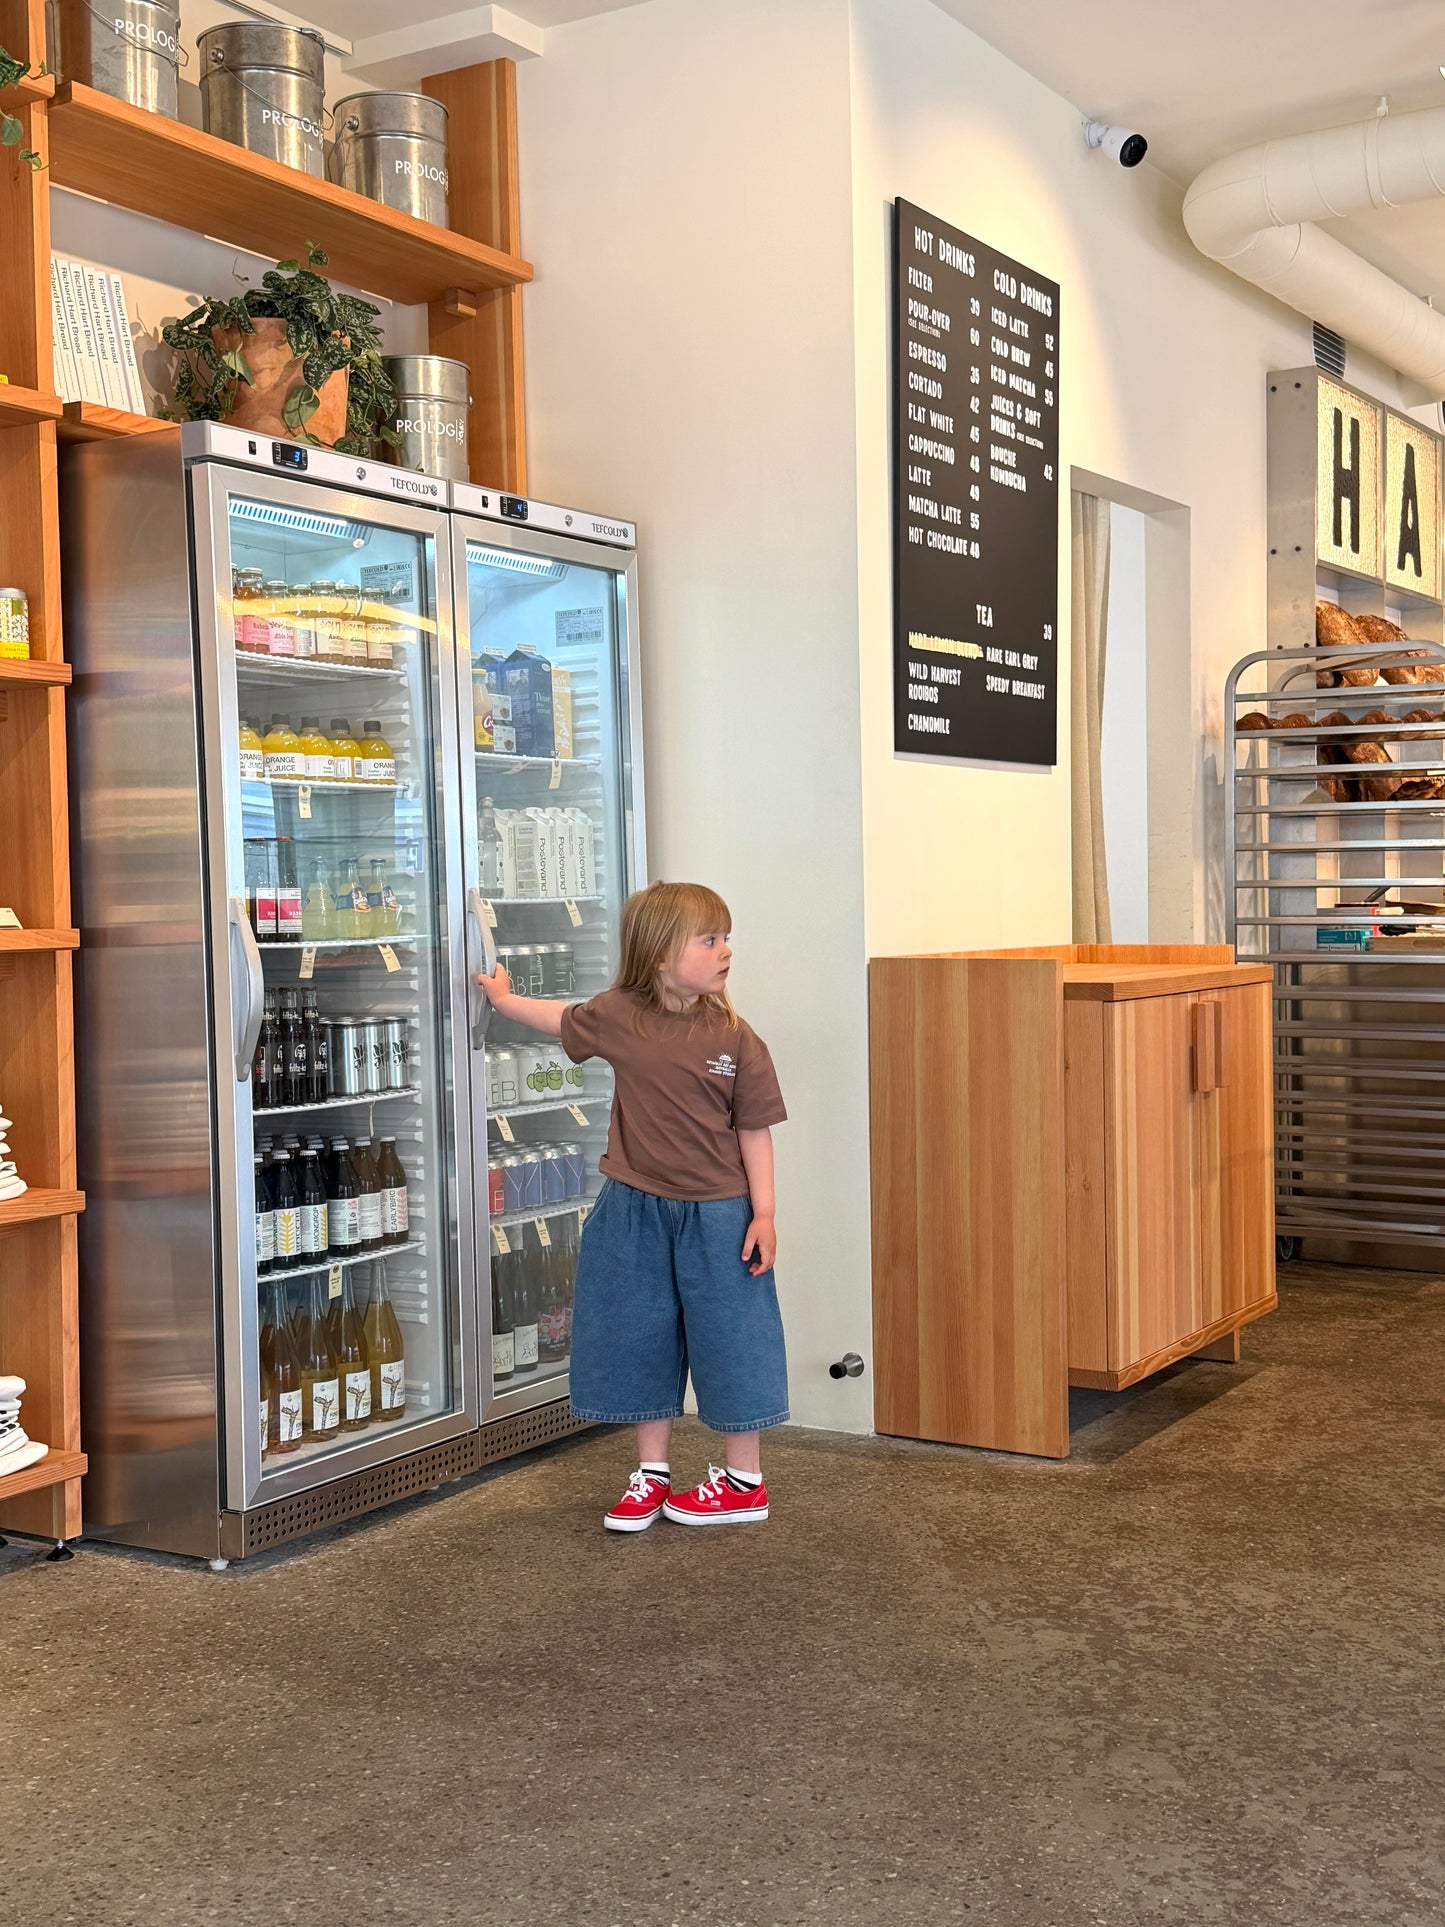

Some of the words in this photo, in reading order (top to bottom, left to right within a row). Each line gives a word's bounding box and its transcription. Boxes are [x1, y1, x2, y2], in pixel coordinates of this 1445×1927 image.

[115, 19, 175, 52] PROLOG
[263, 109, 319, 137] PROLOG
[395, 160, 445, 185] PROLOG
[914, 226, 933, 256] HOT
[939, 238, 975, 278] DRINKS
[61, 267, 73, 303] Richard
[74, 271, 86, 306] Richard
[87, 274, 99, 310] Richard
[98, 278, 110, 313] Richard
[113, 281, 126, 317] Richard
[908, 266, 933, 293] FILTER
[970, 297, 980, 317] 39
[993, 268, 1017, 299] COLD
[1020, 282, 1052, 317] DRINKS
[55, 301, 63, 321] Hart
[68, 304, 77, 324] Hart
[81, 308, 89, 328] Hart
[94, 311, 103, 332] Hart
[104, 315, 113, 335] Hart
[908, 298, 951, 332] POUR-OVER
[970, 327, 980, 347] 60
[991, 306, 1007, 329] ICED
[1009, 315, 1029, 338] LATTE
[57, 322, 69, 350] Bread
[71, 326, 83, 354] Bread
[120, 319, 129, 338] Hart
[84, 330, 95, 358] Bread
[97, 333, 108, 360] Bread
[108, 336, 119, 364] Bread
[124, 339, 134, 366] Bread
[991, 335, 1009, 358] COLD
[1011, 345, 1031, 368] BREW
[1044, 360, 1054, 379] 45
[908, 340, 947, 373] ESPRESSO
[970, 365, 980, 385] 35
[908, 371, 942, 400] CORTADO
[970, 395, 980, 414] 42
[990, 364, 1007, 386] ICED
[1009, 372, 1036, 398] MATCHA
[1044, 388, 1054, 407] 55
[908, 402, 926, 424] FLAT
[929, 410, 954, 434] WHITE
[970, 425, 980, 443] 45
[990, 394, 1014, 418] JUICES
[1025, 407, 1041, 429] SOFT
[396, 419, 456, 437] PROLOG
[990, 413, 1016, 439] DRINKS
[294, 451, 300, 462] 3
[908, 434, 955, 465] CAPPUCCINO
[990, 443, 1017, 468] BOUCHE
[390, 477, 429, 495] TEFCOLD
[908, 464, 931, 487] LATTE
[990, 464, 1027, 493] KOMBUCHA
[1044, 464, 1053, 481] 42
[908, 494, 939, 519] MATCHA
[941, 504, 961, 525] LATTE
[970, 512, 980, 530] 55
[591, 522, 622, 537] TEFCOLD
[908, 526, 924, 545] HOT
[927, 530, 968, 556] CHOCOLATE
[976, 604, 993, 628] TEA
[986, 646, 1003, 664] RARE
[1004, 649, 1021, 668] EARL
[1022, 653, 1038, 671] GREY
[908, 661, 928, 680] WILD
[931, 665, 961, 686] HARVEST
[986, 674, 1010, 693] SPEEDY
[1012, 680, 1045, 700] BREAKFAST
[908, 683, 939, 704] ROOIBOS
[908, 713, 950, 735] CHAMOMILE
[558, 836, 567, 890] Postevand
[578, 836, 587, 890] Postevand
[312, 1207, 320, 1250] LEMONDROP
